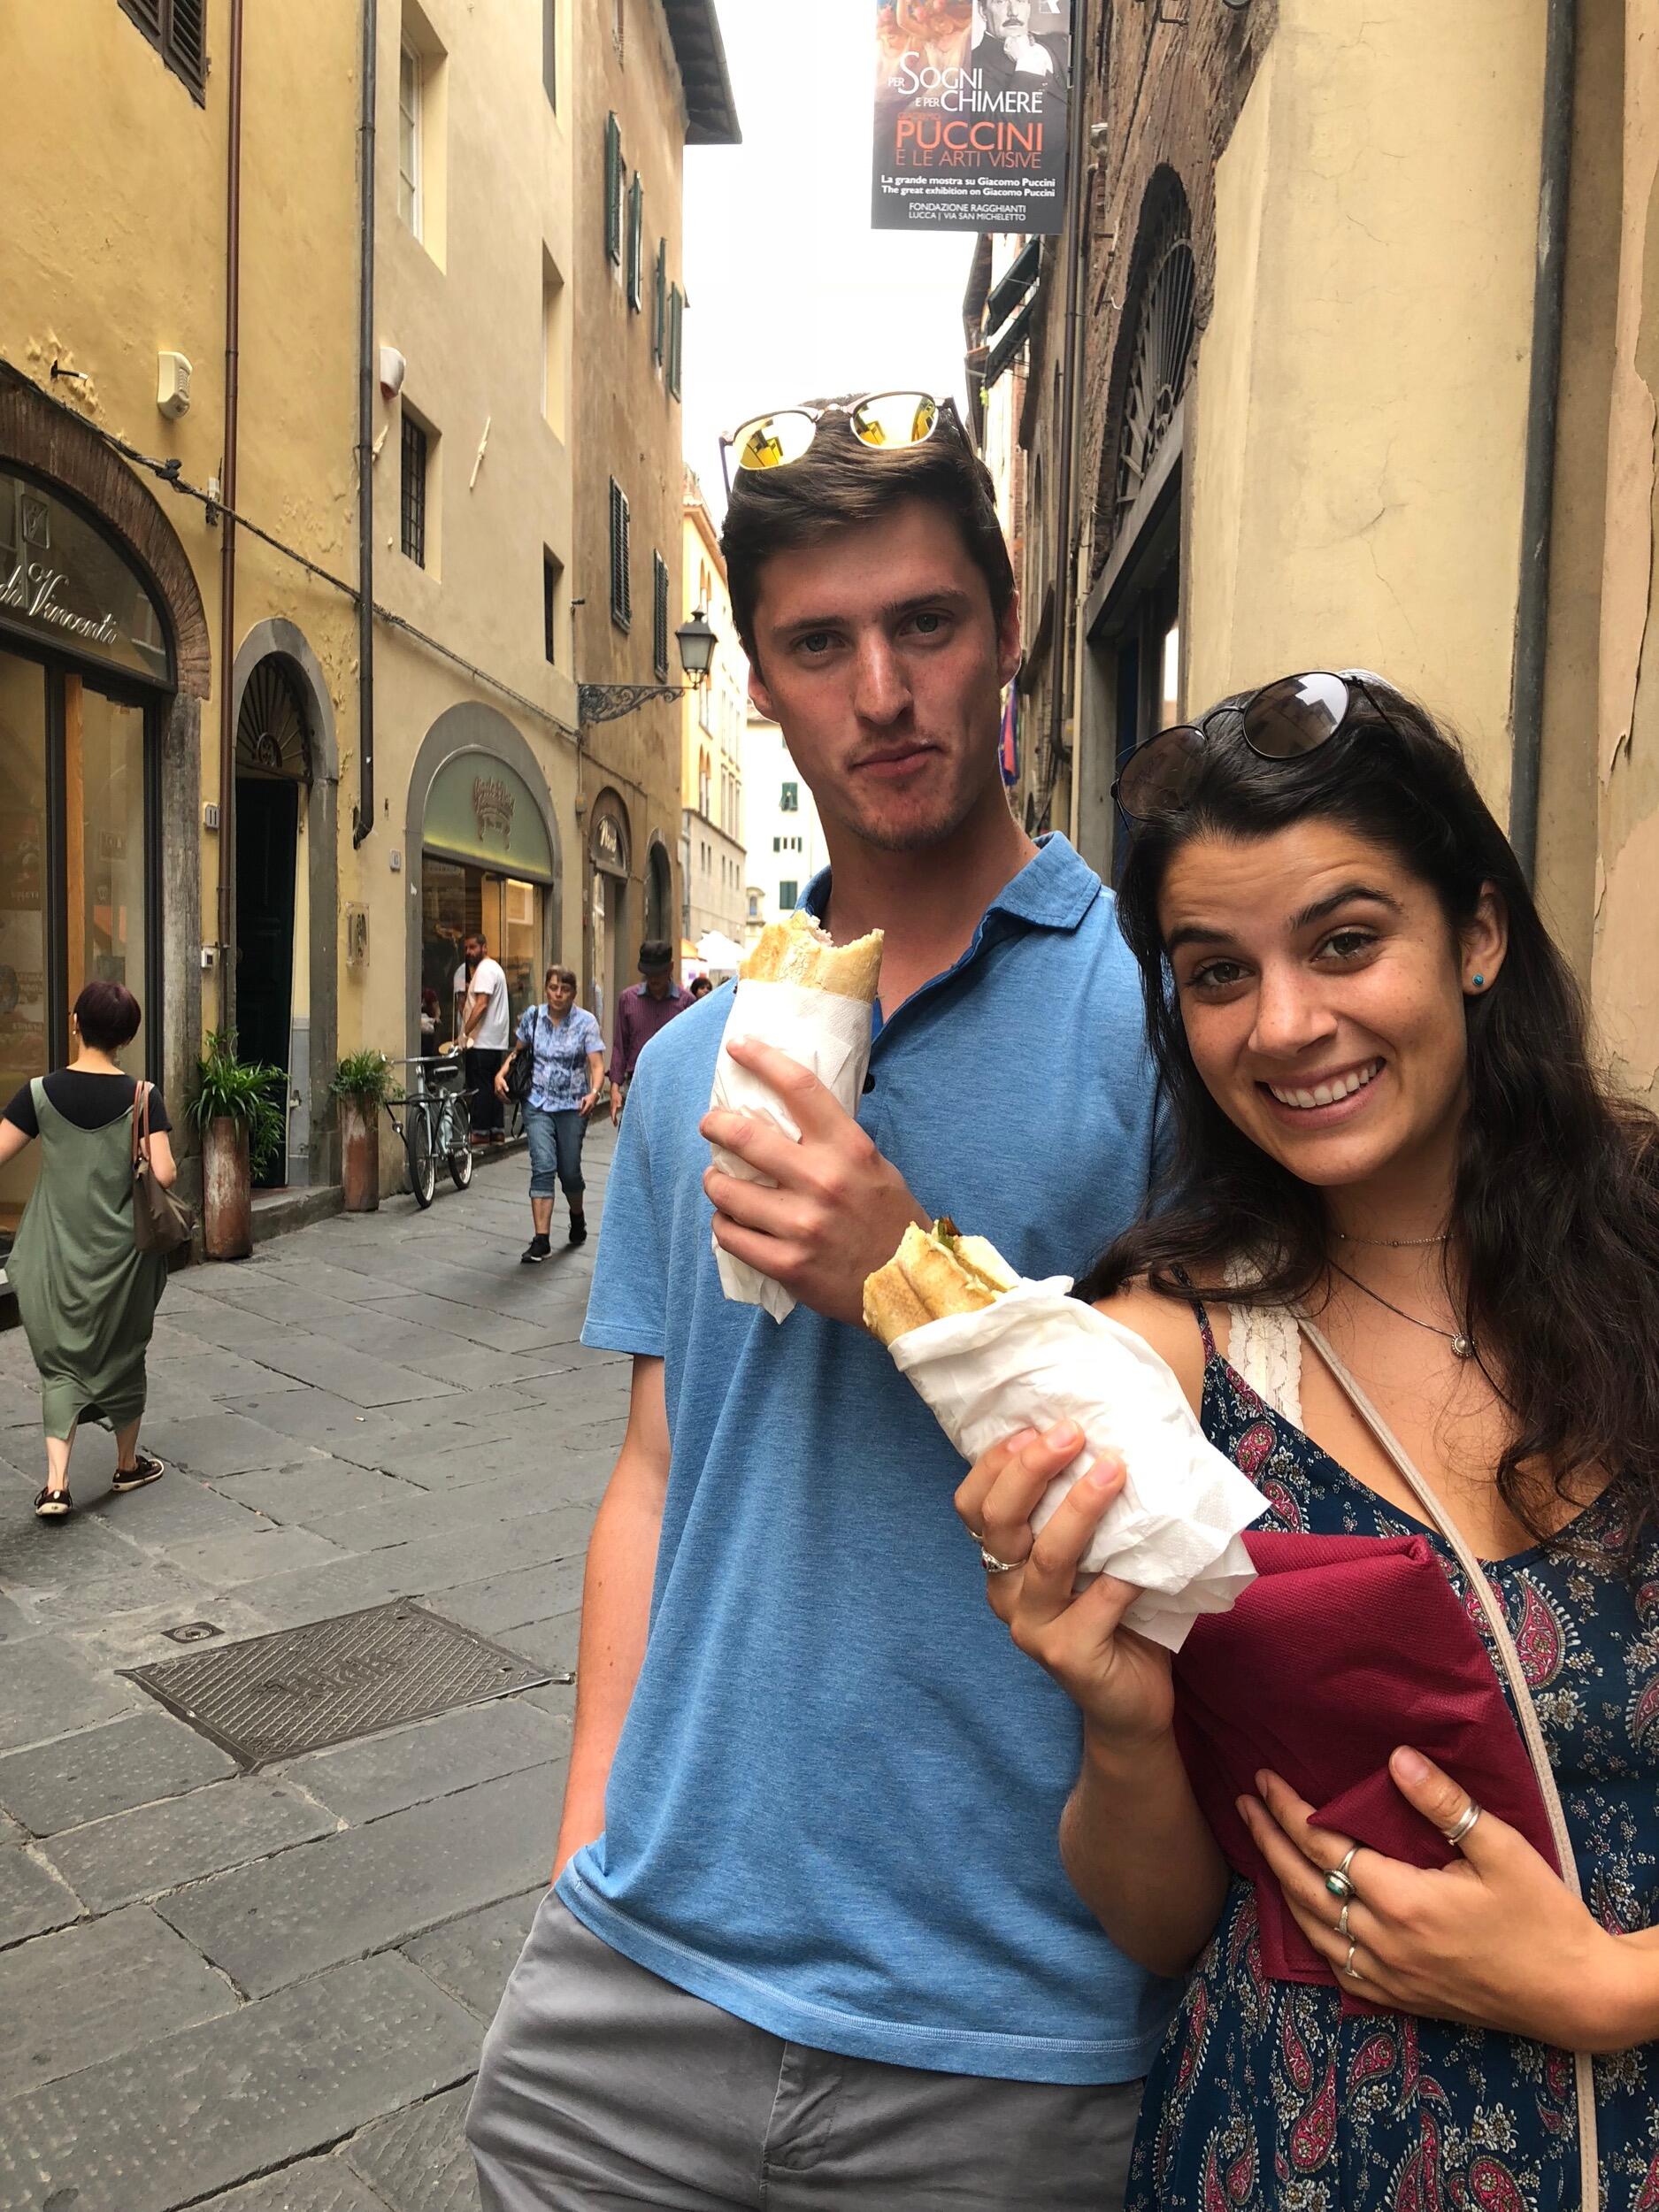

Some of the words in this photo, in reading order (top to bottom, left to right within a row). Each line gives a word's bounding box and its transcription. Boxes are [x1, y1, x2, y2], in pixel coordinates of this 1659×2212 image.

[887, 76, 905, 87] PER
[897, 50, 982, 95] SOGNI
[915, 96, 922, 107] E
[923, 97, 940, 107] PER
[940, 89, 1043, 113] CHIMERE
[896, 119, 1043, 151] PUCCINI
[895, 149, 907, 165] E
[912, 150, 933, 166] LE
[938, 150, 981, 167] ARTI
[987, 151, 1042, 169] VISIVE
[882, 185, 899, 194] The
[983, 188, 1023, 196] Giacomo
[895, 176, 927, 186] grande
[978, 177, 1020, 187] Giacomo
[1022, 178, 1056, 187] Puccini
[910, 203, 969, 212] FONDAZIONE
[971, 204, 1026, 213] RAGGHIANTI
